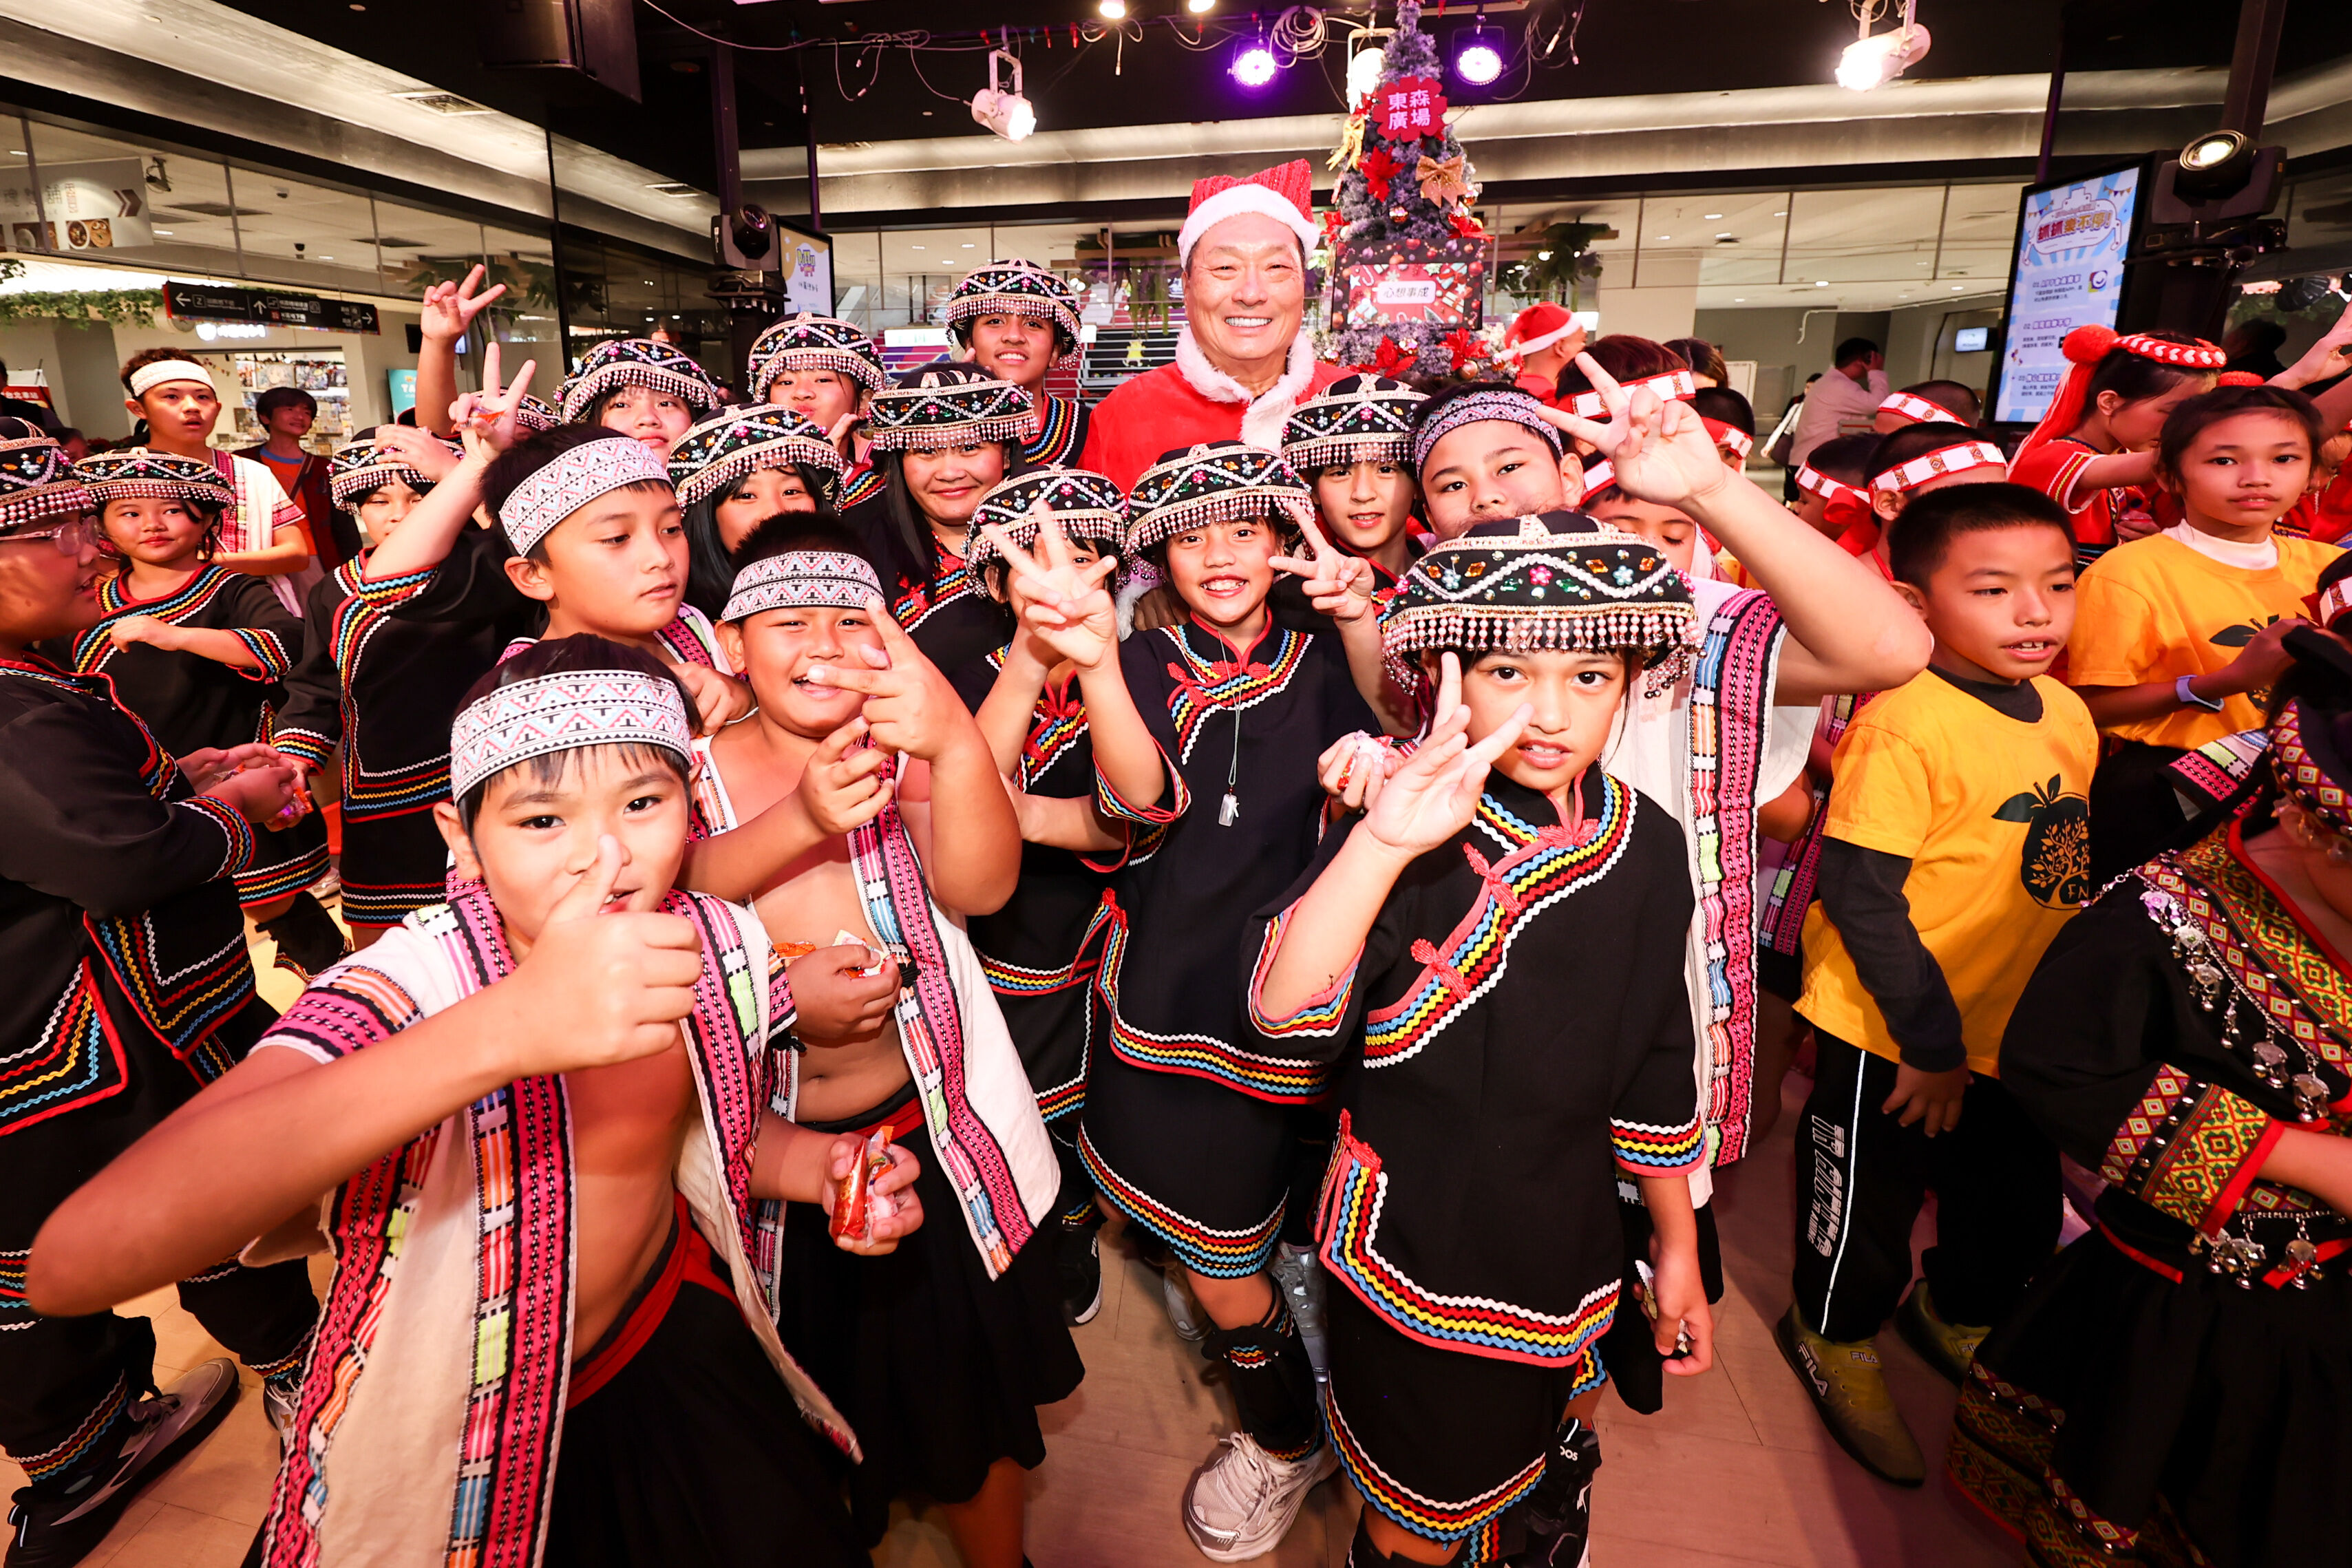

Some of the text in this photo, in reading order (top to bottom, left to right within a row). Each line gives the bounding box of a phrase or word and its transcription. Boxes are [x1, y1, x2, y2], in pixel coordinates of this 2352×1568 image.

[1388, 89, 1431, 111] 東森
[1388, 107, 1431, 131] 廣場
[1384, 286, 1430, 299] 心想事成
[1850, 1351, 1878, 1364] FILA
[1798, 1342, 1828, 1397] FILA
